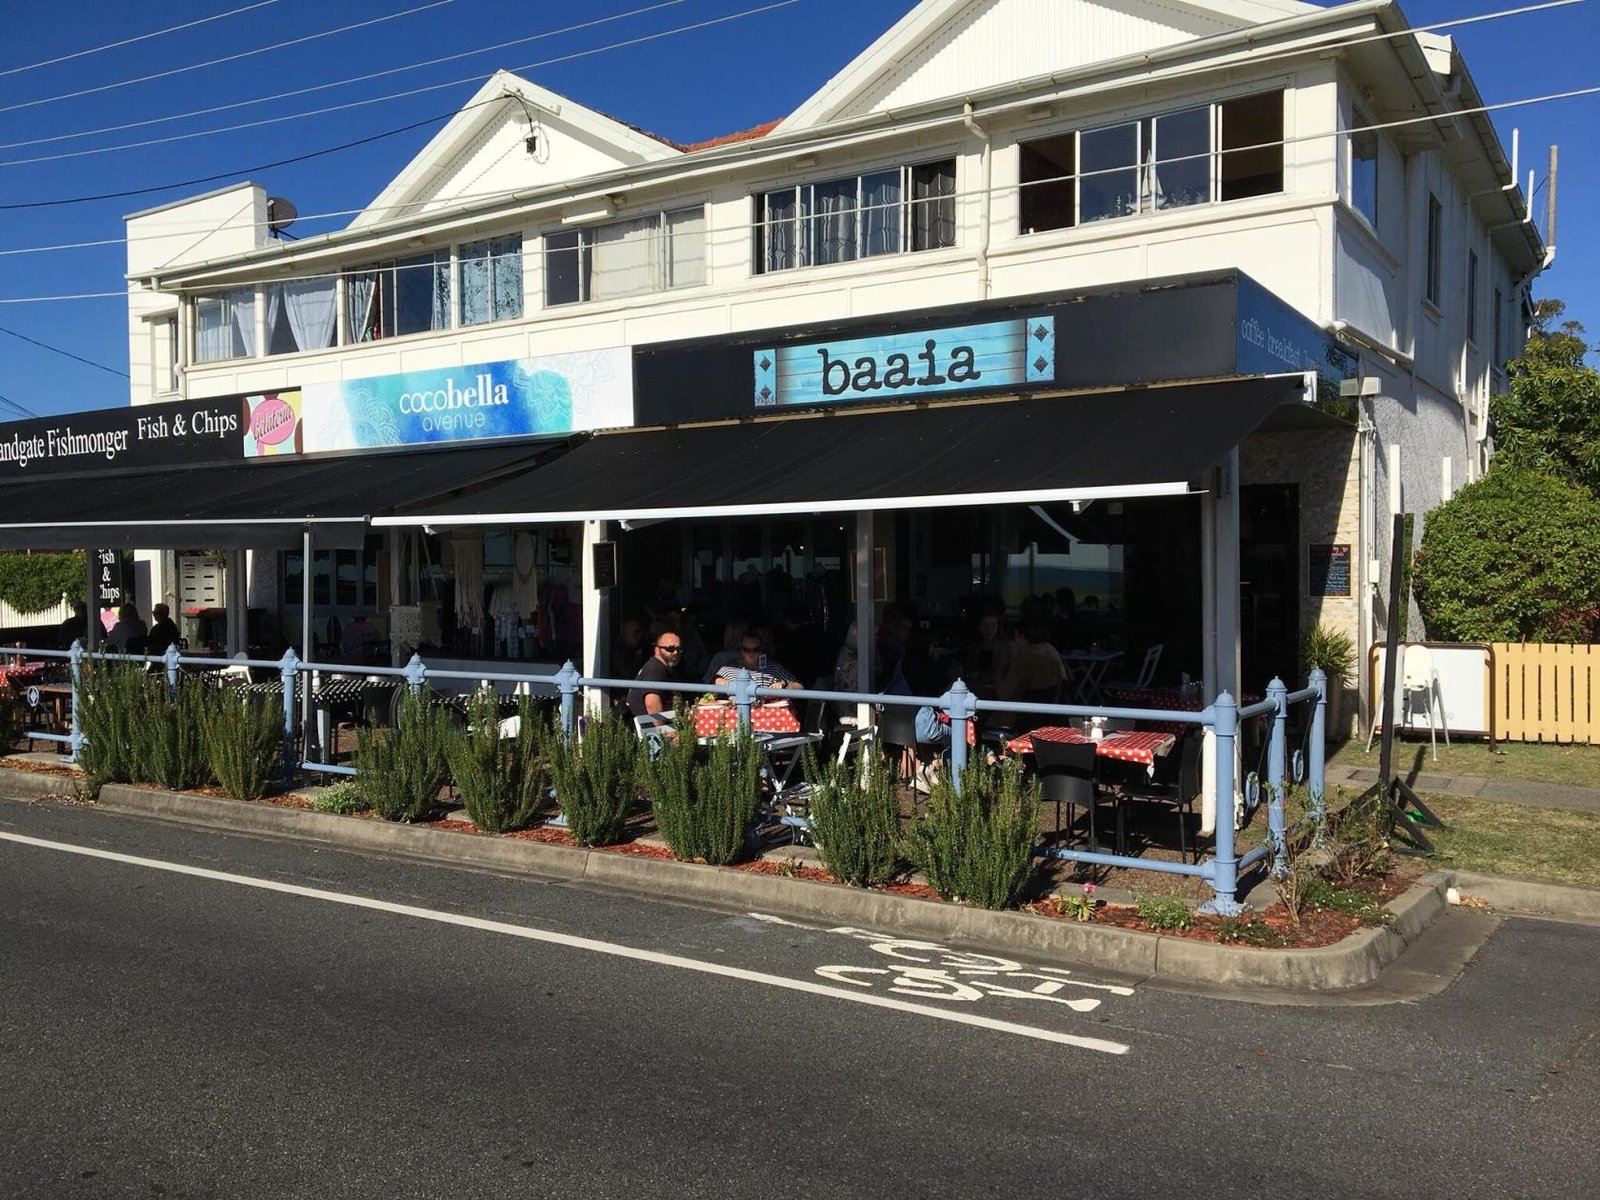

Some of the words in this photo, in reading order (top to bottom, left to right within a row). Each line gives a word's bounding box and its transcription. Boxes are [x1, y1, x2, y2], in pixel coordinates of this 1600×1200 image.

[1241, 318, 1265, 348] coffee
[817, 339, 981, 395] baaia
[399, 374, 509, 415] cocobella
[137, 414, 168, 440] Fish
[173, 413, 187, 436] &
[192, 409, 237, 438] Chips
[422, 412, 486, 432] avenue
[47, 428, 128, 460] Fishmonger
[102, 566, 111, 582] &
